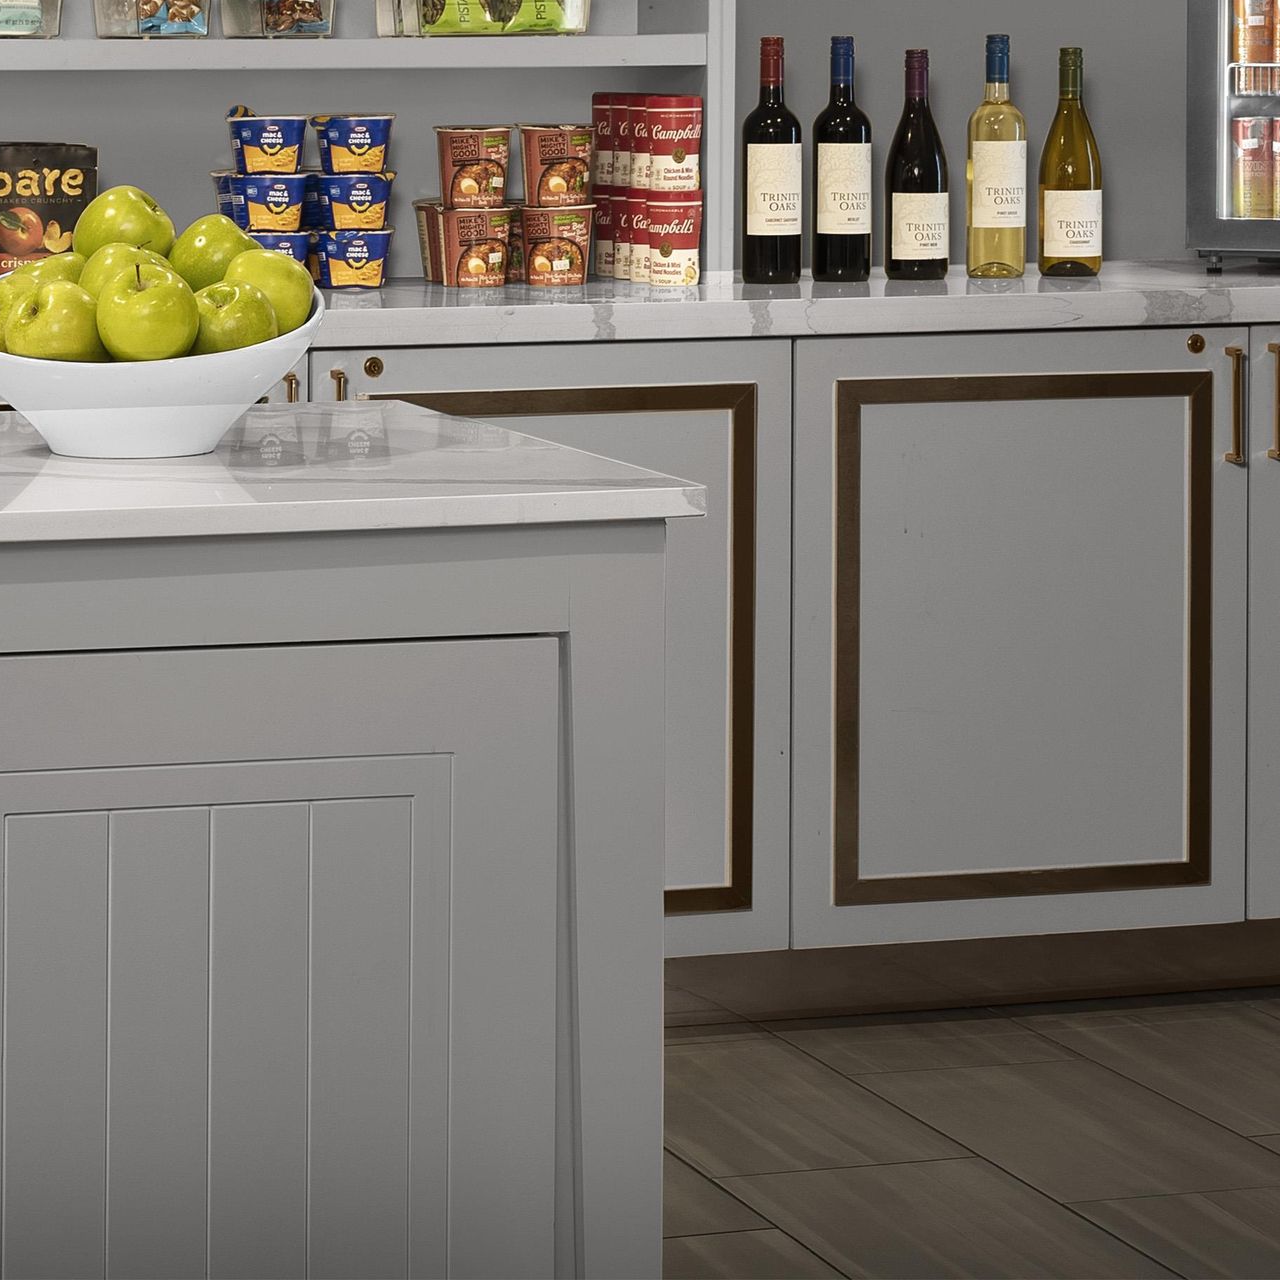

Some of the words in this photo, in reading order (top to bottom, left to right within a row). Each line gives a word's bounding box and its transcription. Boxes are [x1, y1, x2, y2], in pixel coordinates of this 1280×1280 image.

[451, 135, 478, 145] MIKE'S
[540, 134, 567, 144] MIKE'S
[451, 143, 478, 151] MIGHTY
[540, 142, 567, 150] MIGHTY
[453, 150, 478, 158] GOOD
[541, 148, 566, 157] GOOD
[760, 192, 800, 202] TRINITY
[770, 201, 796, 211] OAKS
[906, 223, 946, 233] TRINITY
